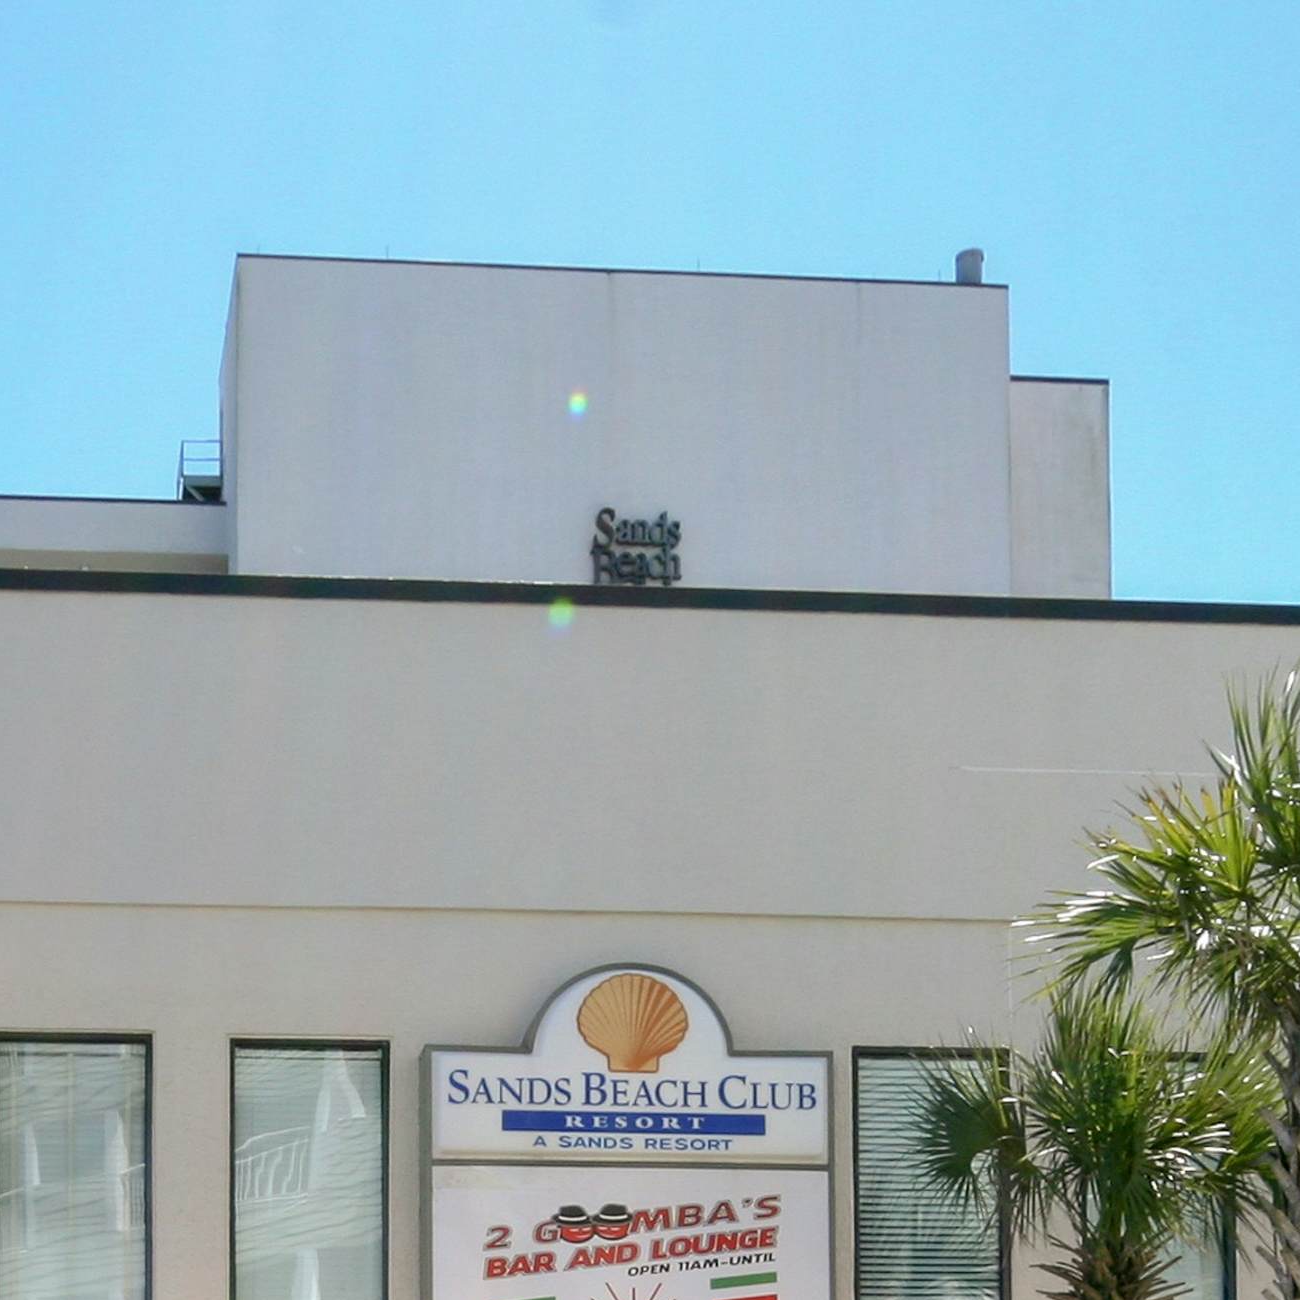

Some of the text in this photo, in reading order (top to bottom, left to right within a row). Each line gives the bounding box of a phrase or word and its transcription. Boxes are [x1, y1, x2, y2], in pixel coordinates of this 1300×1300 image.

[595, 507, 682, 549] Sands
[448, 1069, 817, 1110] SANDS BEACH CLUB
[565, 1114, 707, 1130] RESORT
[533, 1136, 732, 1151] A SANDS RESORT
[485, 1227, 511, 1249] 2
[483, 1226, 780, 1280] BAR AND LOUNGE
[628, 1263, 671, 1277] OPEN
